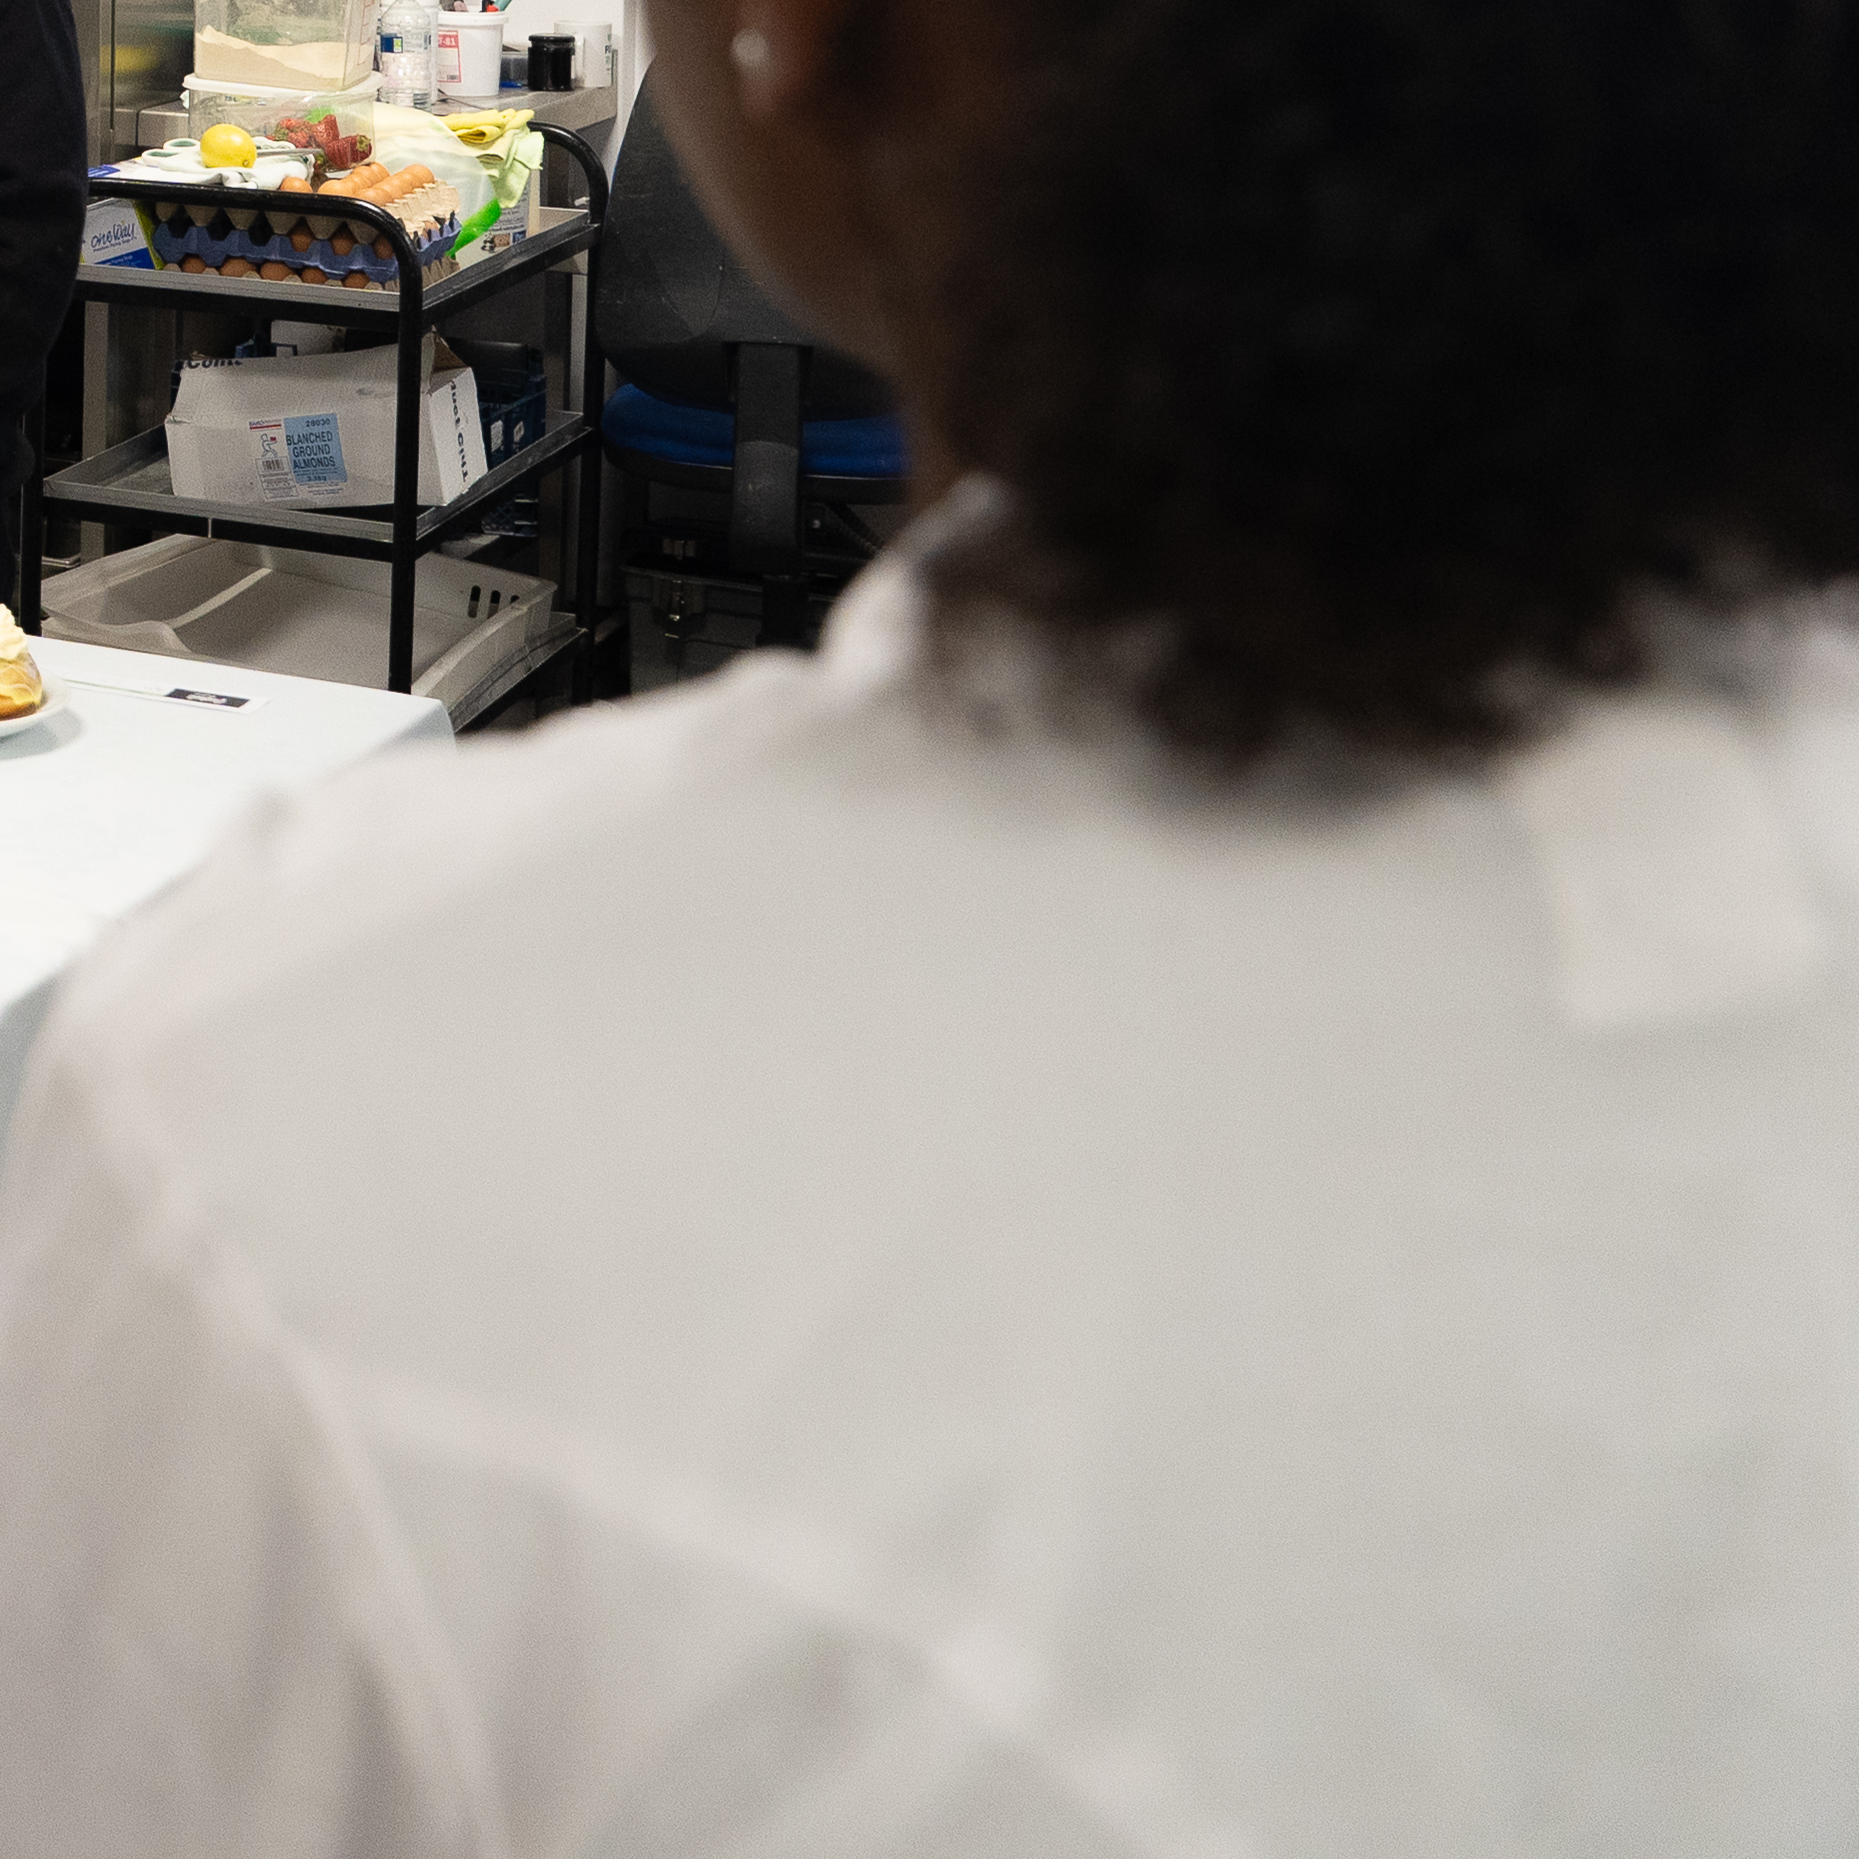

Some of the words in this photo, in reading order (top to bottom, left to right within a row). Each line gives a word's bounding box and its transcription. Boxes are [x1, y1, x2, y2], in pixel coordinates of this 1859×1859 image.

[285, 431, 333, 446] BLANCHED
[292, 444, 331, 458] GROUND
[293, 456, 336, 470] ALMONDS
